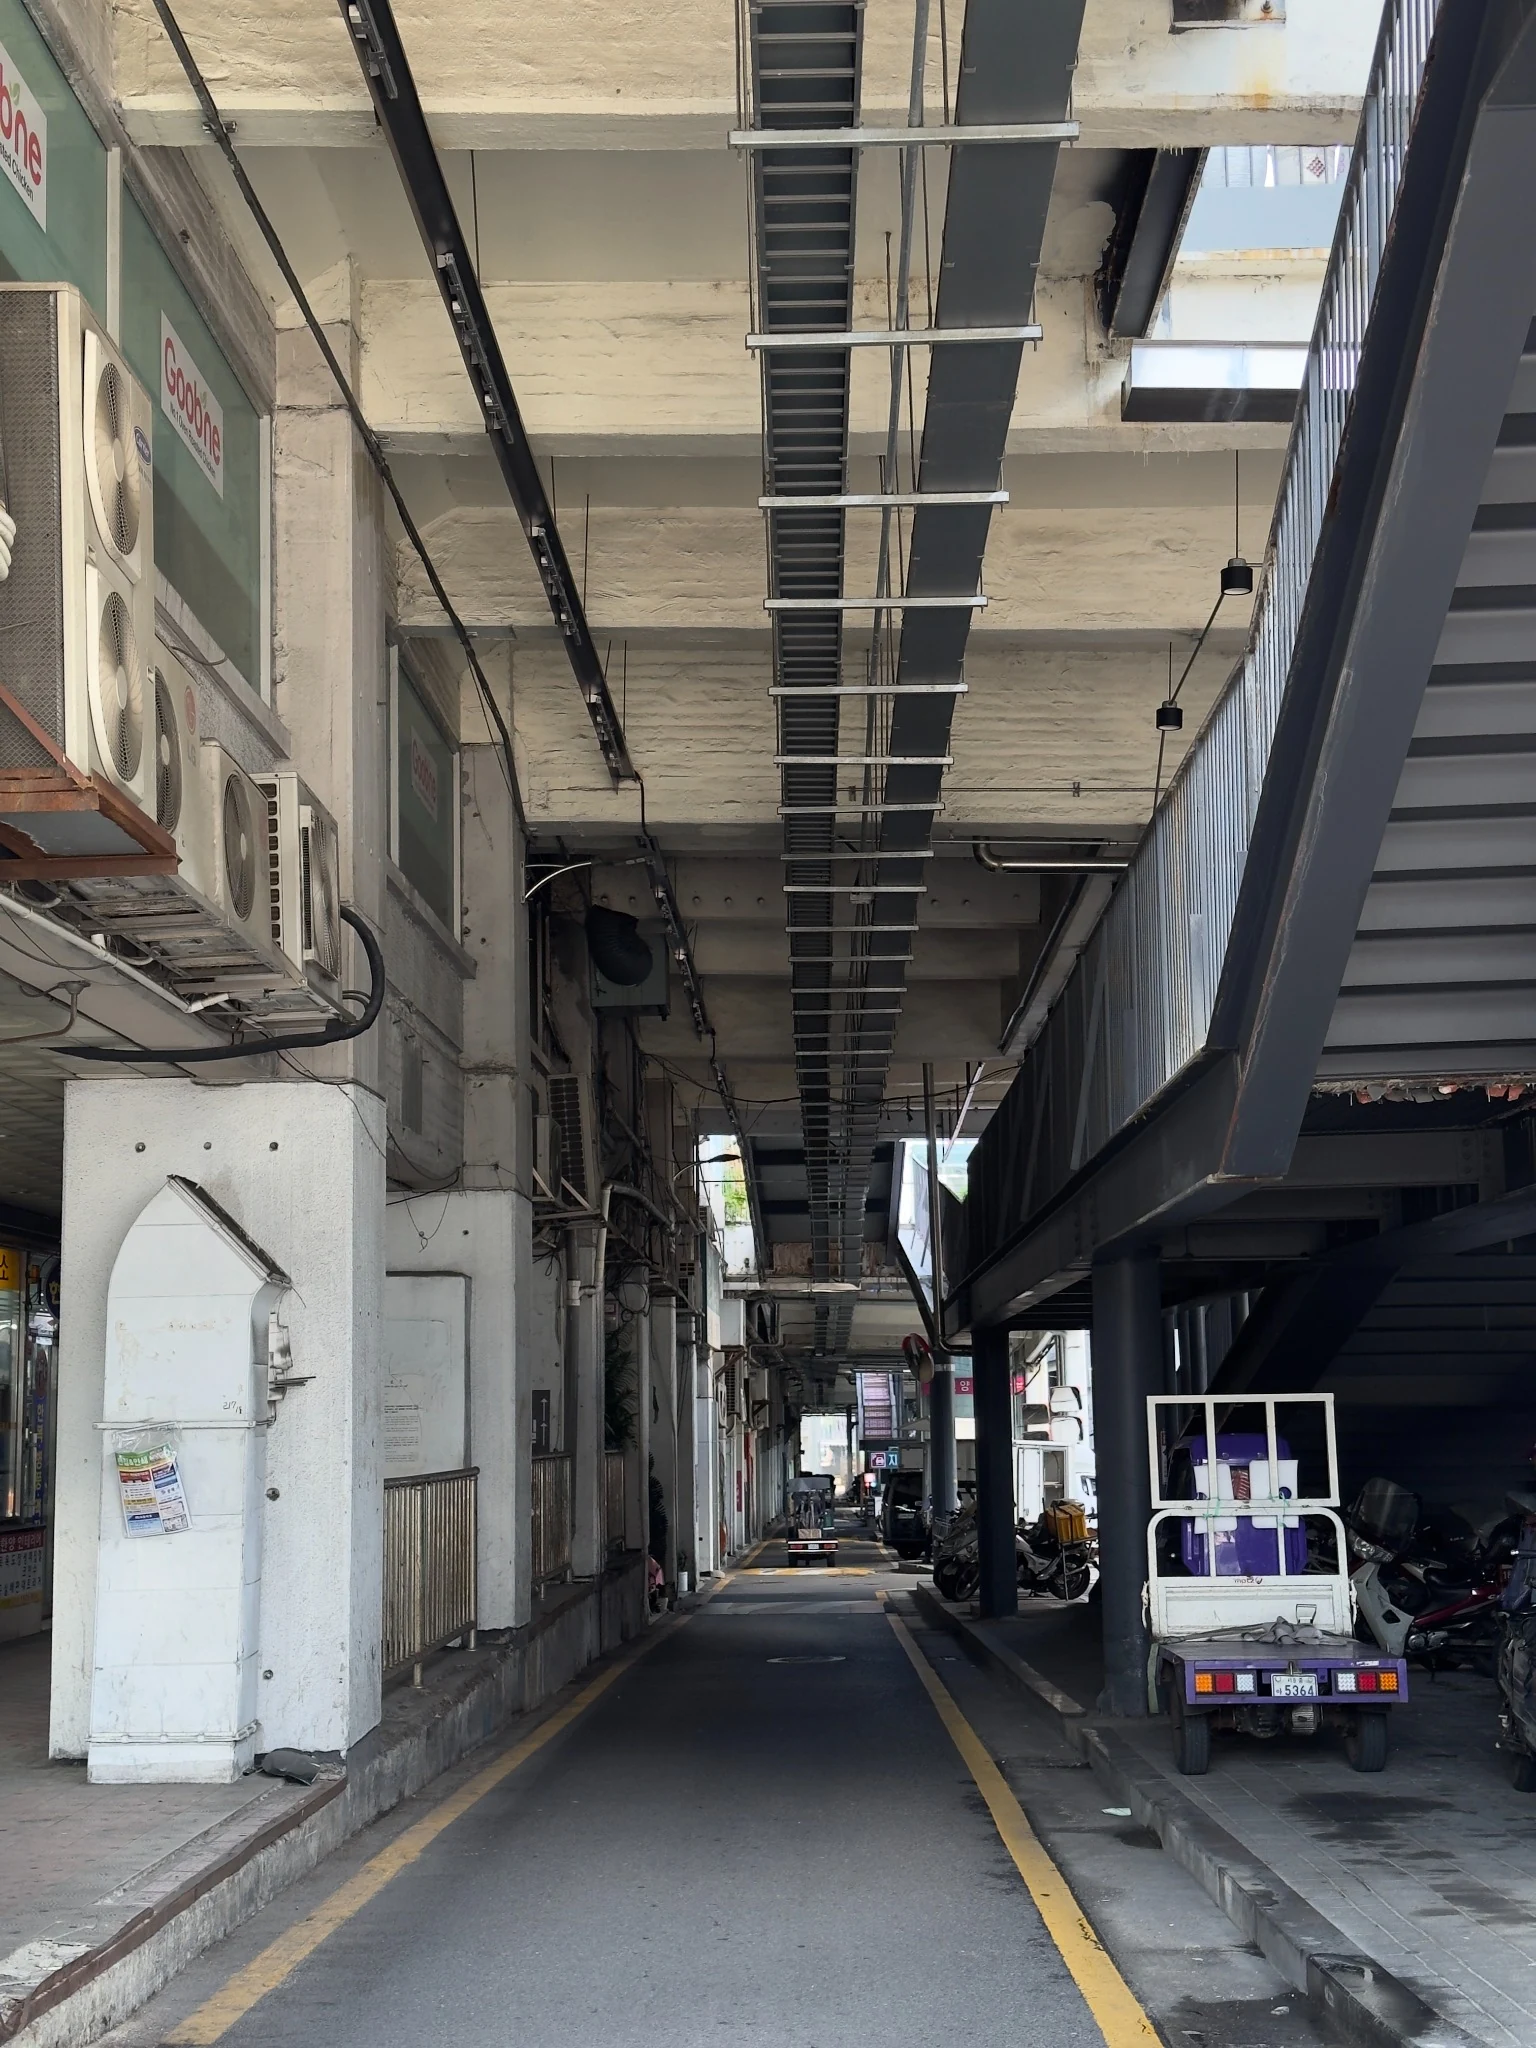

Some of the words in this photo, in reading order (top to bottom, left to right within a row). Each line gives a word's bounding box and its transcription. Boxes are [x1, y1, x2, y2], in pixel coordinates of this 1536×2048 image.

[12, 158, 34, 203] Chicken
[165, 337, 220, 466] Goobne
[202, 451, 216, 478] Chicken
[187, 739, 197, 769] LG
[888, 1454, 898, 1466] 지
[17, 1531, 42, 1550] 인테리어
[1285, 1685, 1314, 1697] 5364
